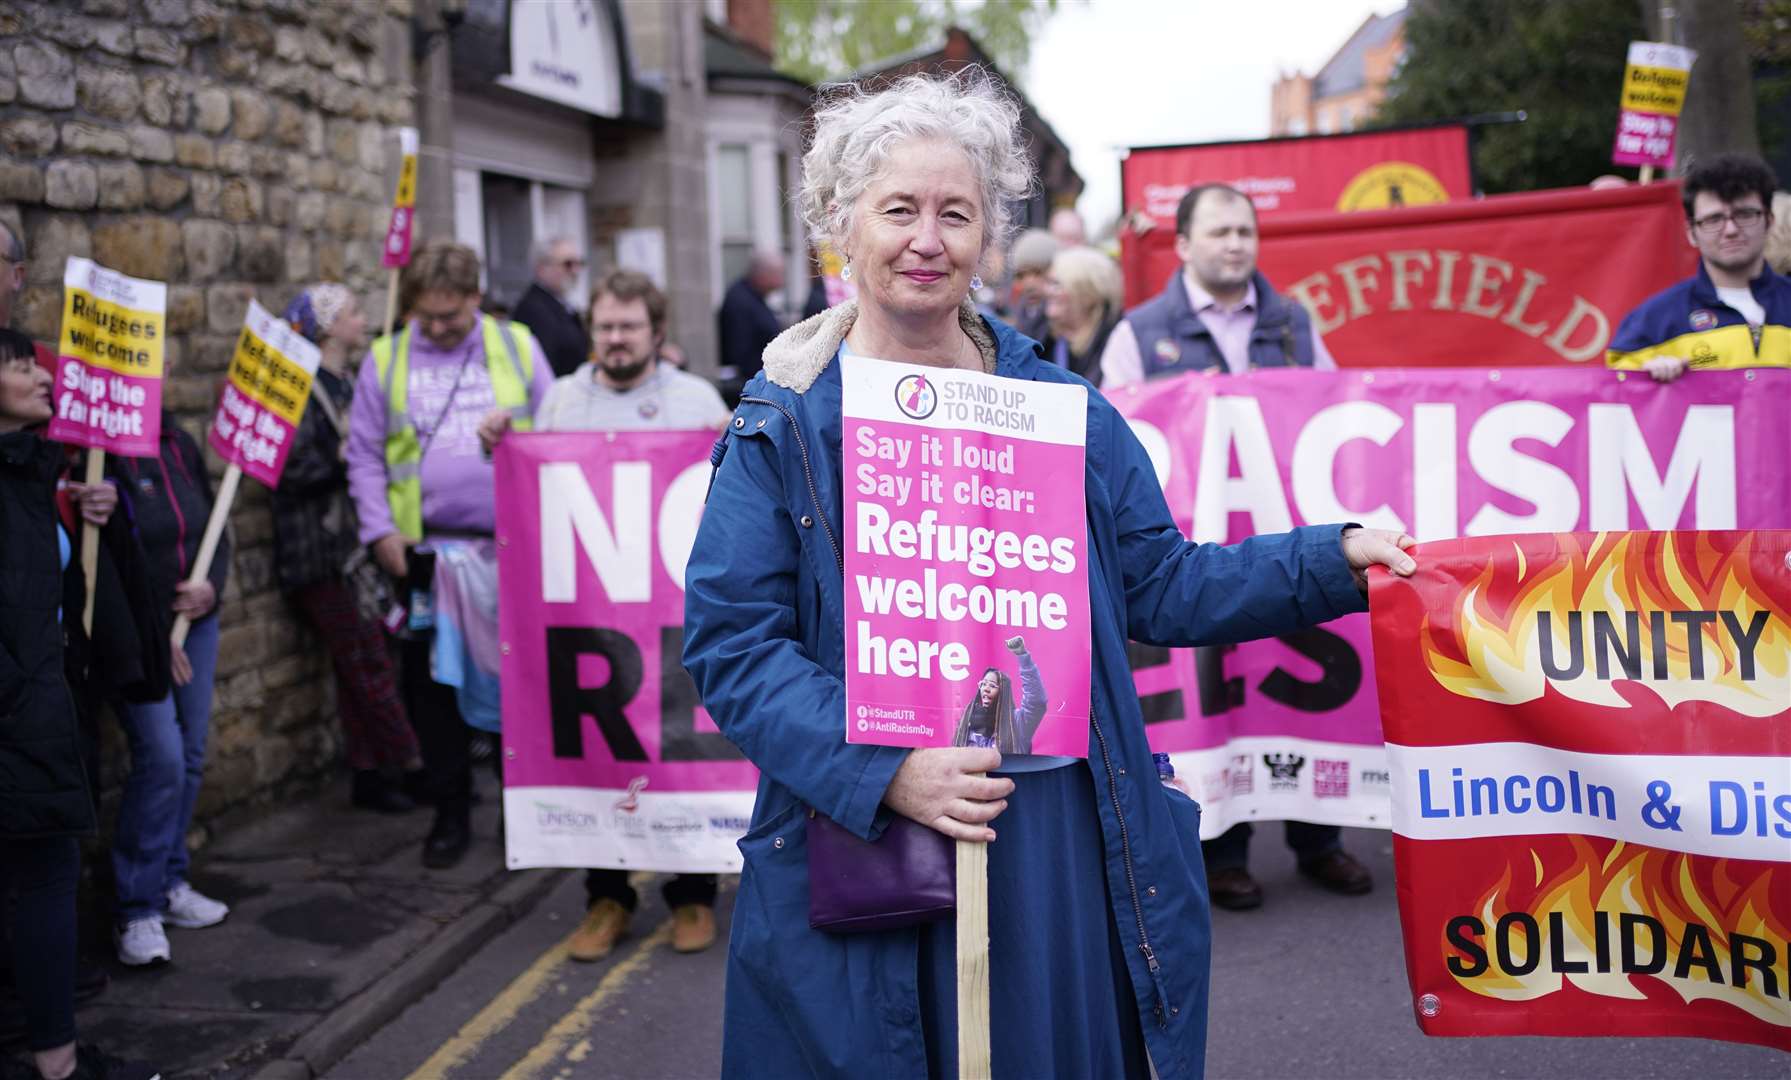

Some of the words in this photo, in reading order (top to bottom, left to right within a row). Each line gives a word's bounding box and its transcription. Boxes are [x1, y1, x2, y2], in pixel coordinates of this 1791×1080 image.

[72, 294, 156, 338] Refugees
[1289, 249, 1610, 362] EFFIELD
[69, 328, 150, 368] welcome
[62, 360, 106, 403] Stop
[109, 376, 146, 408] the
[943, 381, 999, 407] STAND
[1003, 390, 1026, 410] UP
[89, 404, 143, 438] right
[256, 410, 286, 445] the
[944, 402, 969, 421] TO
[973, 409, 1035, 432] RACISM
[233, 427, 278, 468] right
[856, 426, 913, 469] Say
[921, 434, 944, 467] it
[953, 437, 1014, 475] loud
[1128, 396, 1737, 545] ACISM
[856, 463, 913, 506] Say
[921, 471, 944, 504] it
[953, 475, 1035, 513] clear:
[856, 501, 1076, 577] Refugees
[855, 567, 1068, 630] welcome
[857, 620, 970, 681] here
[1537, 610, 1770, 682] UNITY
[869, 706, 915, 720] @StandUTR
[869, 721, 934, 737] @AntiRacismDay
[1418, 768, 1617, 822] Lincoln
[1640, 779, 1684, 832] &
[1446, 910, 1791, 1001] SOLIDAR
